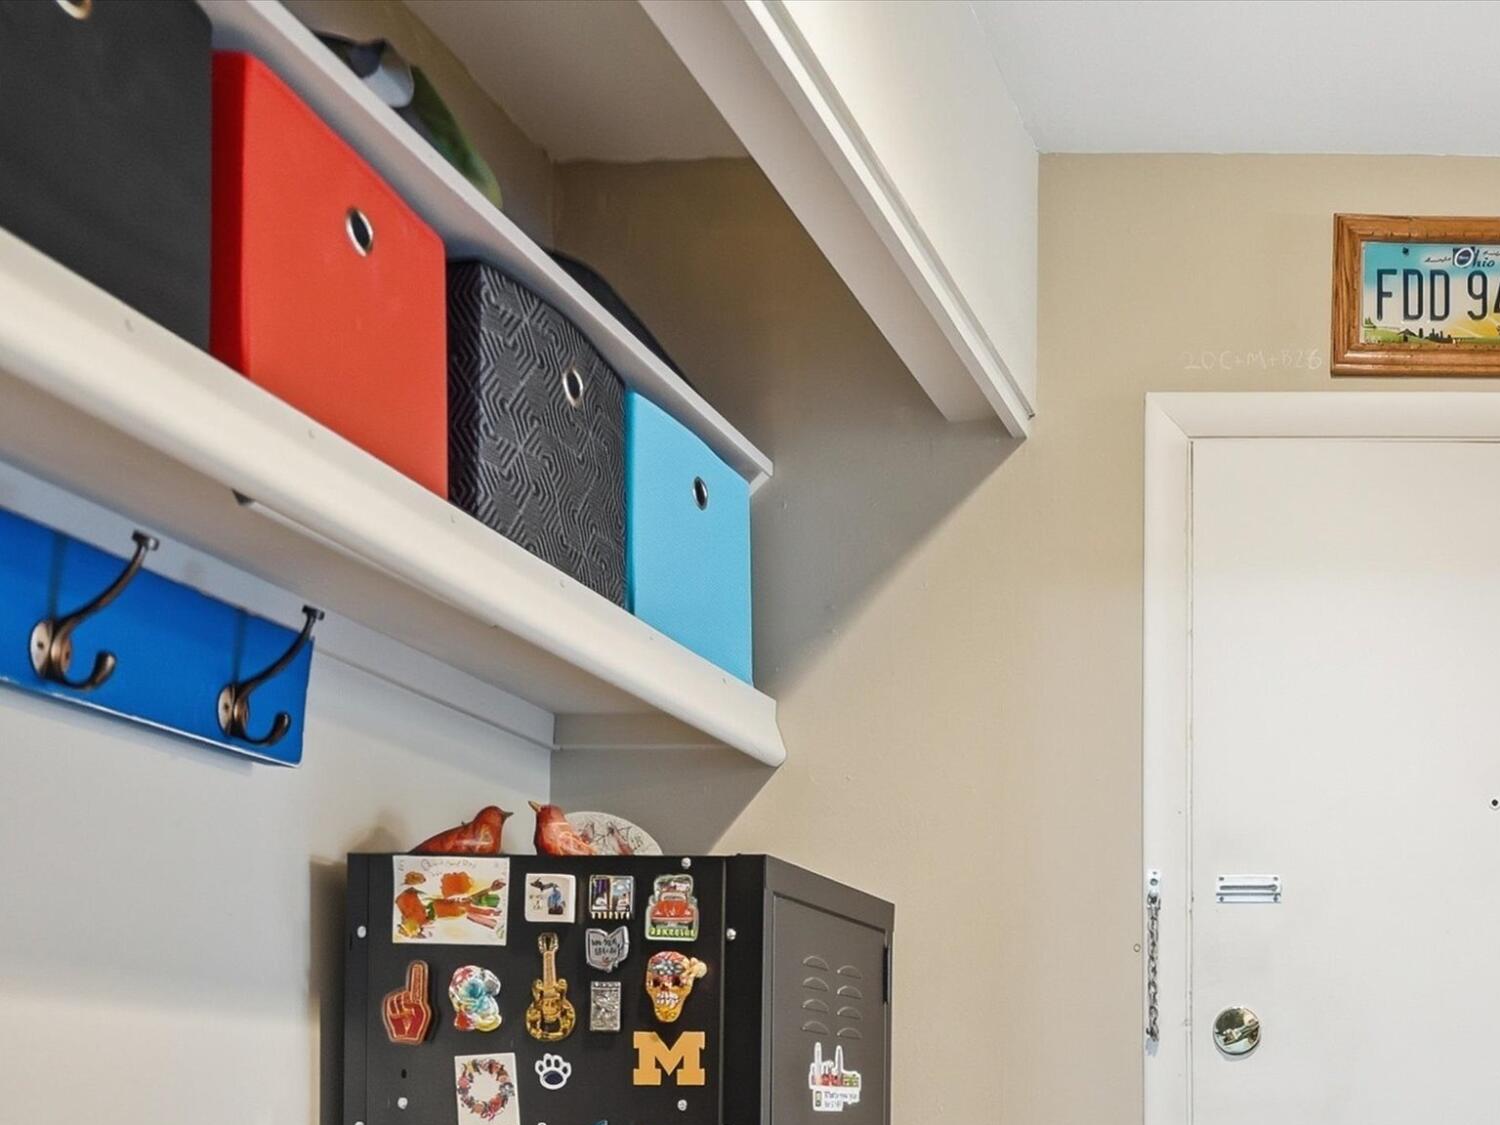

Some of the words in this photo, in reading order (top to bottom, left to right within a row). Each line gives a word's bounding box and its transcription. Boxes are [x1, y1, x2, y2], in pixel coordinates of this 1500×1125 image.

[1453, 246, 1496, 269] Ohio
[1376, 268, 1450, 321] FDD
[633, 1030, 705, 1085] M
